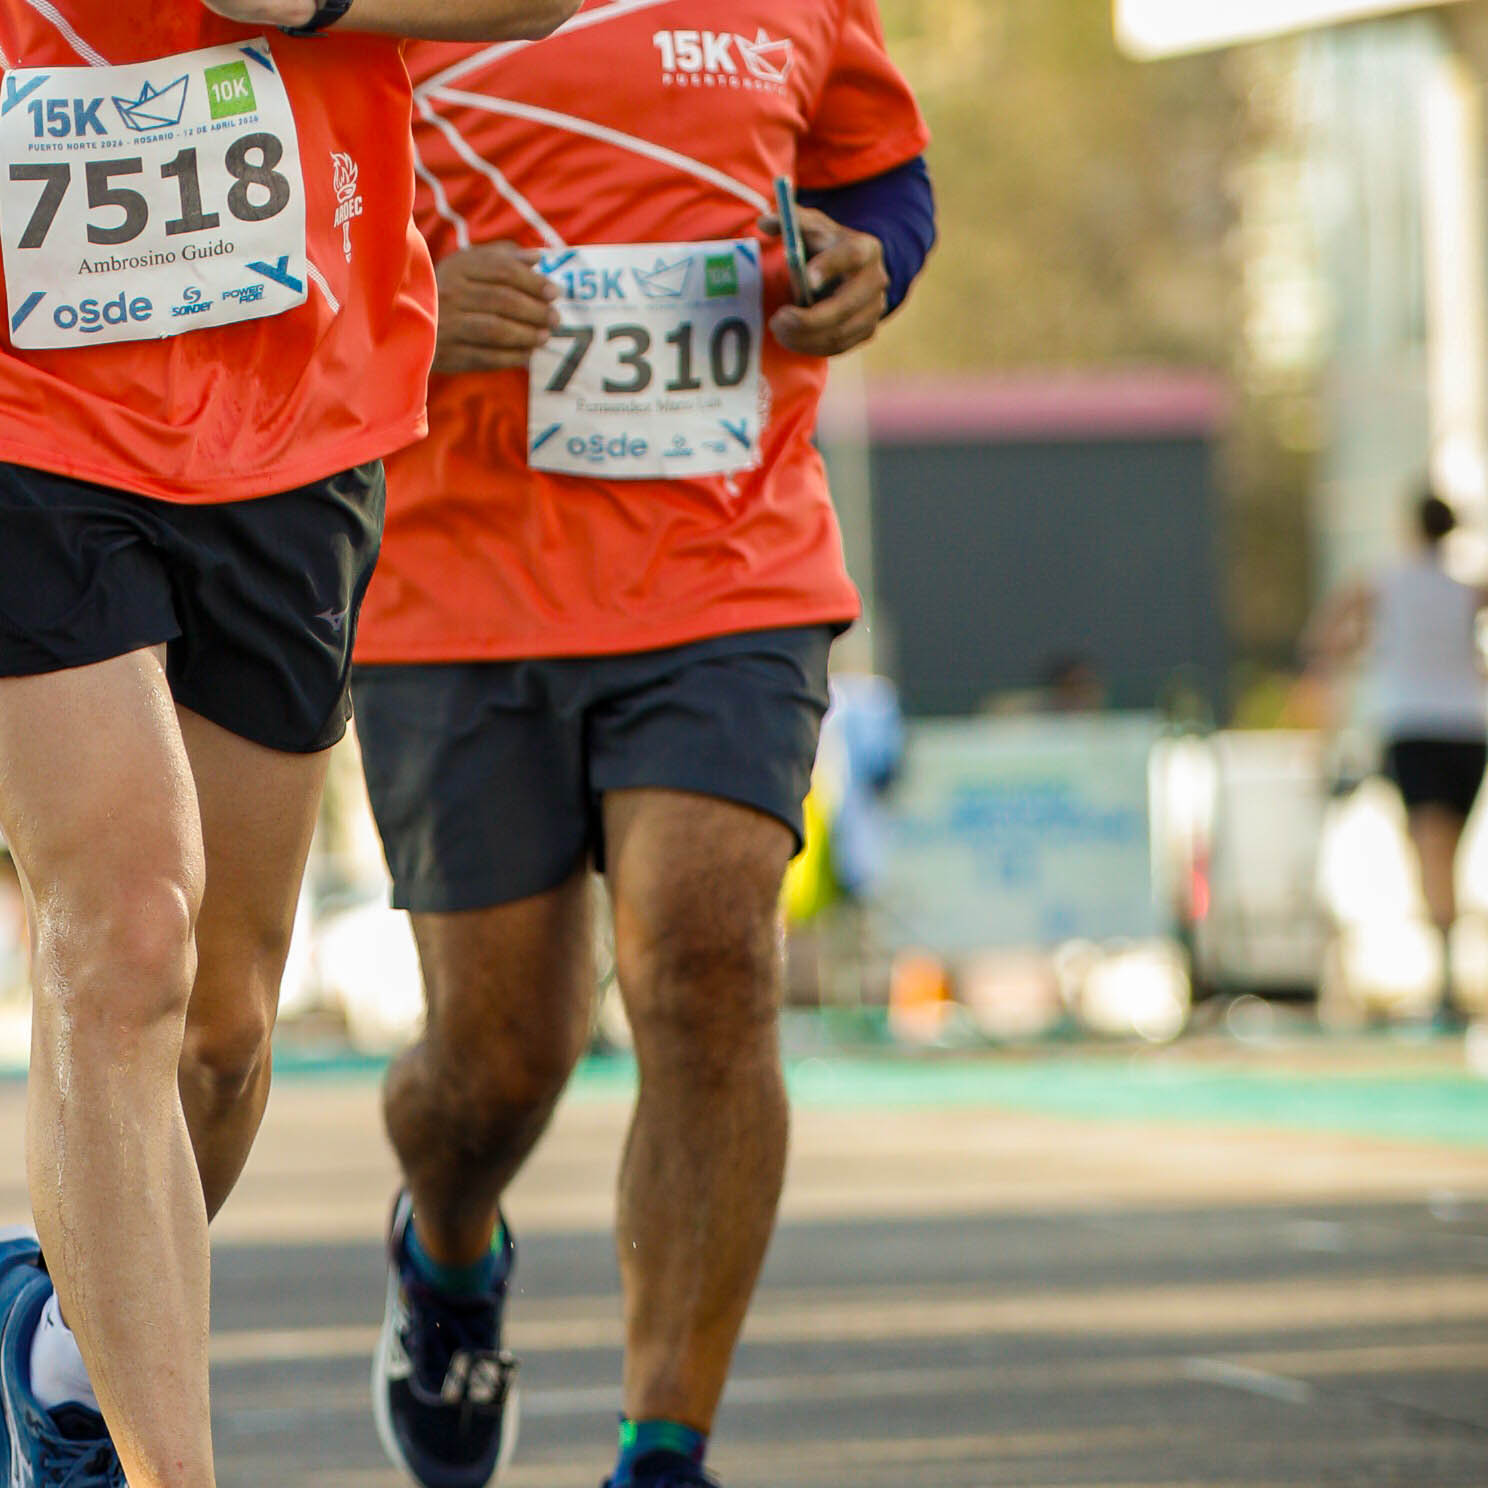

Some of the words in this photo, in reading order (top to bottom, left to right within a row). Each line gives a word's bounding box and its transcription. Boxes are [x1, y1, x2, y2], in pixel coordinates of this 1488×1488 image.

[653, 30, 737, 73] 15K
[212, 76, 249, 103] 10K
[27, 97, 109, 137] 15K
[28, 143, 64, 151] PUERTO
[67, 142, 97, 150] NORTE
[133, 132, 174, 145] ROSARIO
[184, 127, 193, 137] 12
[196, 124, 208, 134] DE
[211, 120, 235, 131] ABRIL
[9, 132, 291, 249] 7518
[78, 249, 176, 275] Ambrosino
[182, 239, 235, 261] Guido
[222, 284, 265, 300] POWER
[563, 269, 625, 299] 15K
[53, 291, 153, 333] osde
[545, 316, 751, 393] 7310
[567, 432, 648, 461] osde
